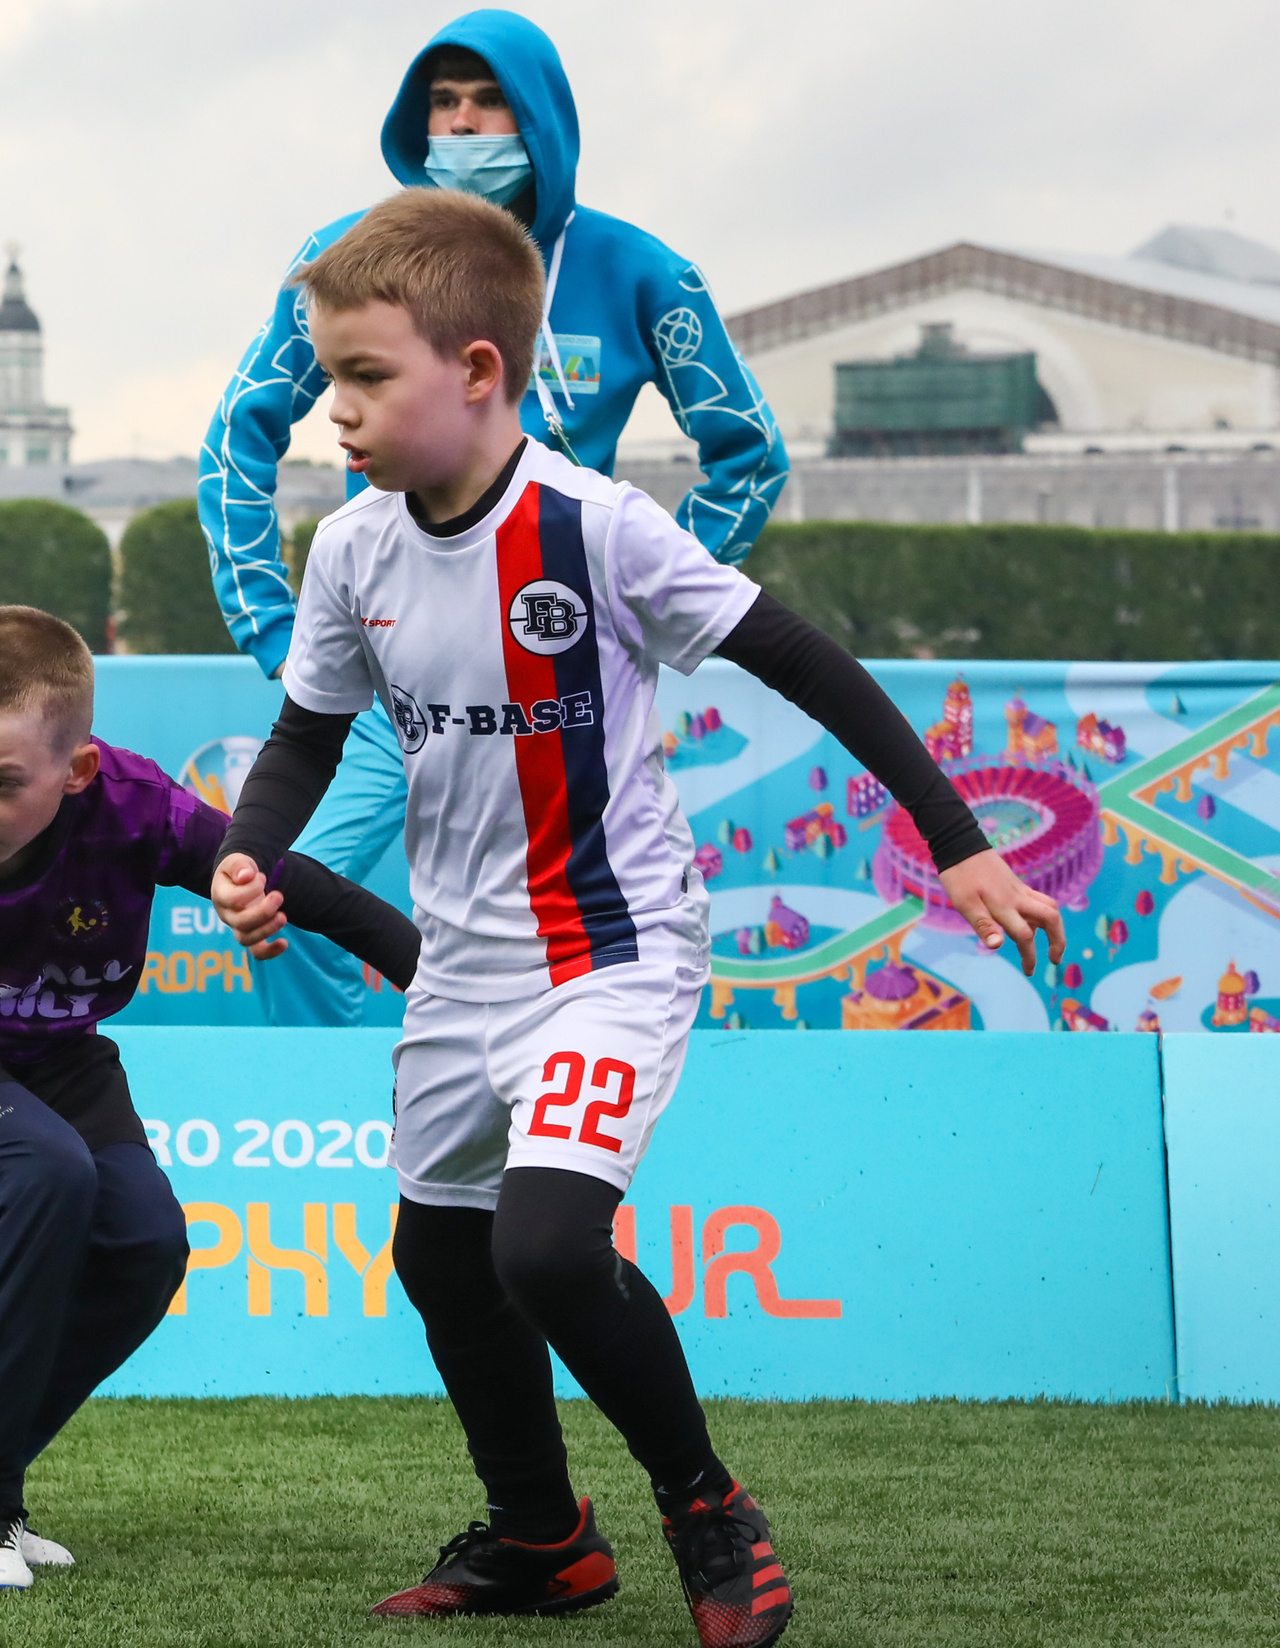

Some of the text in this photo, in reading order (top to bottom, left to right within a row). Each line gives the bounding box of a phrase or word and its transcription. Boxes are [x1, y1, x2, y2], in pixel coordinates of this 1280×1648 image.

[369, 619, 397, 628] SPORT
[427, 690, 594, 737] F-BASE
[138, 951, 252, 993] ROPH
[527, 1051, 636, 1154] 22
[142, 1118, 392, 1168] RO 2020
[613, 1204, 842, 1319] UR
